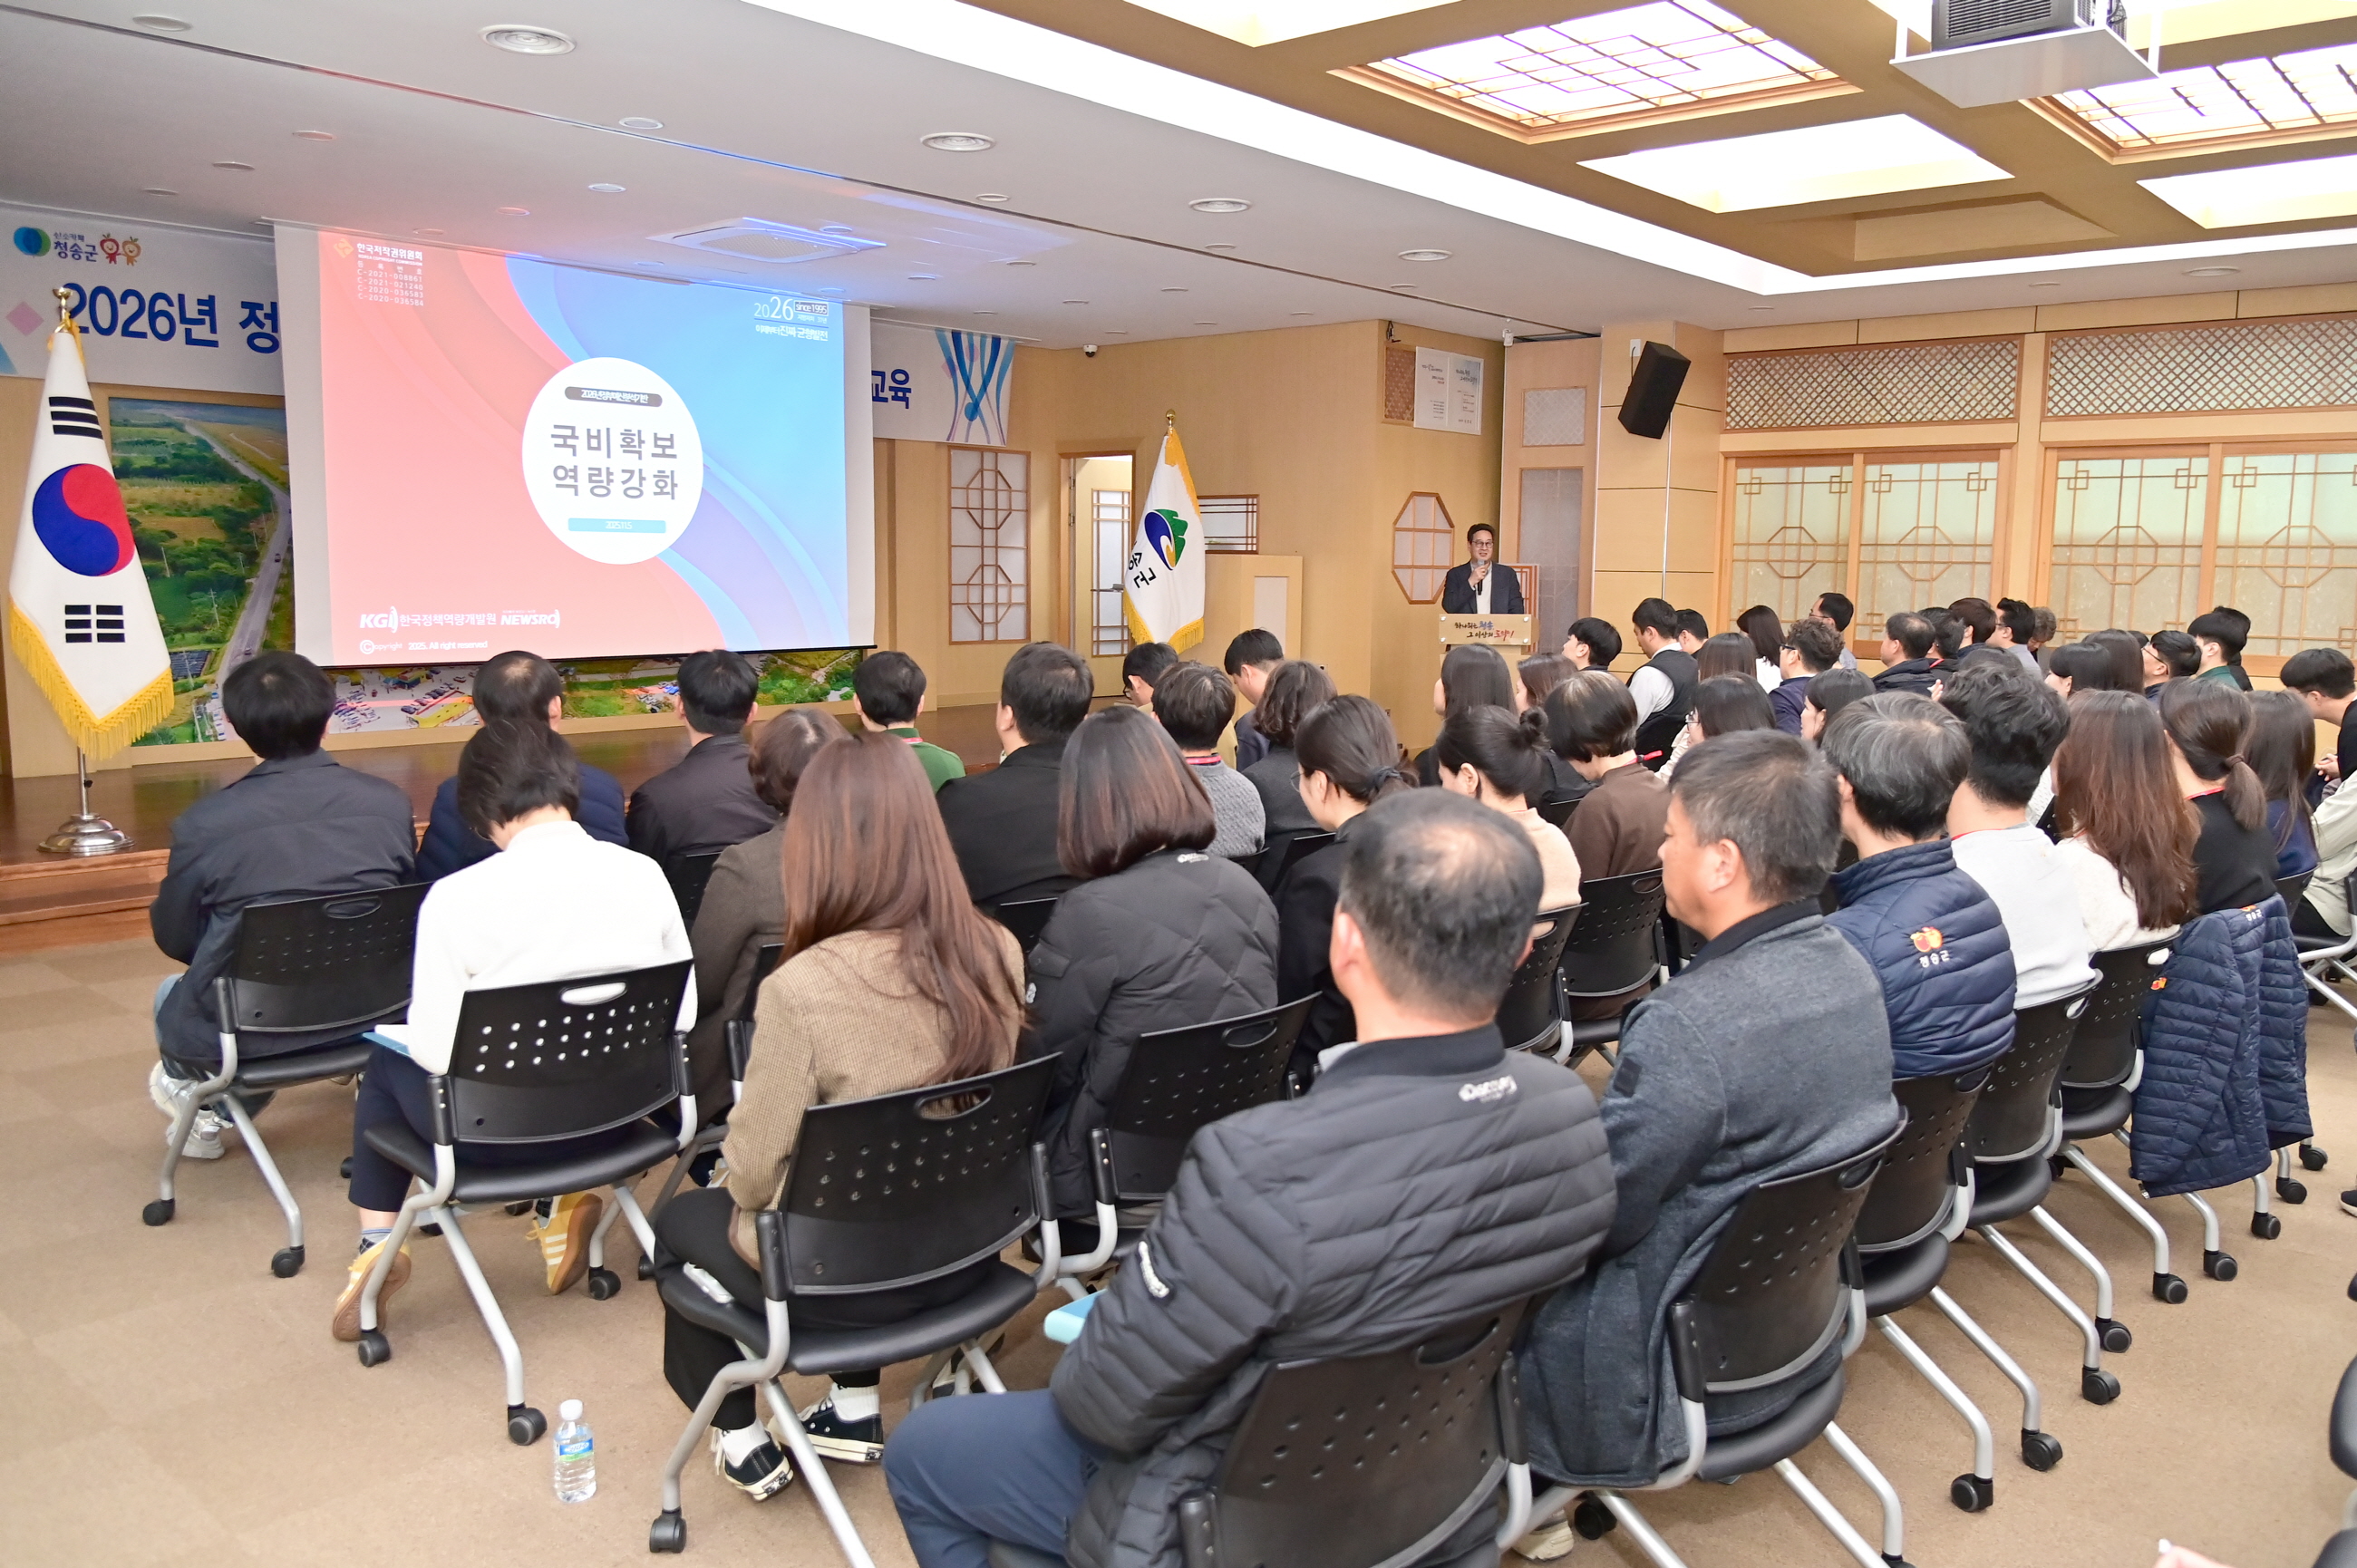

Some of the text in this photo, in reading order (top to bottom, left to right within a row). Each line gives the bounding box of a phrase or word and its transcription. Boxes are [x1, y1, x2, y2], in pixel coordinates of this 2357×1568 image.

[54, 241, 98, 262] 청송군
[356, 243, 422, 261] 한국저작권위원회
[357, 276, 423, 291] C-2021-021240
[357, 285, 423, 298] C-2020-036583
[358, 293, 424, 306] C-2020-036584
[753, 296, 794, 321] 2026
[63, 283, 219, 348] 2026년
[871, 369, 912, 409] 교육
[550, 424, 677, 460] 국비확보
[553, 465, 678, 500] 역량강화
[1129, 552, 1157, 589] 송군
[400, 613, 497, 627] 한국정책역량개발원
[429, 642, 440, 651] All
[457, 641, 489, 650] reserved
